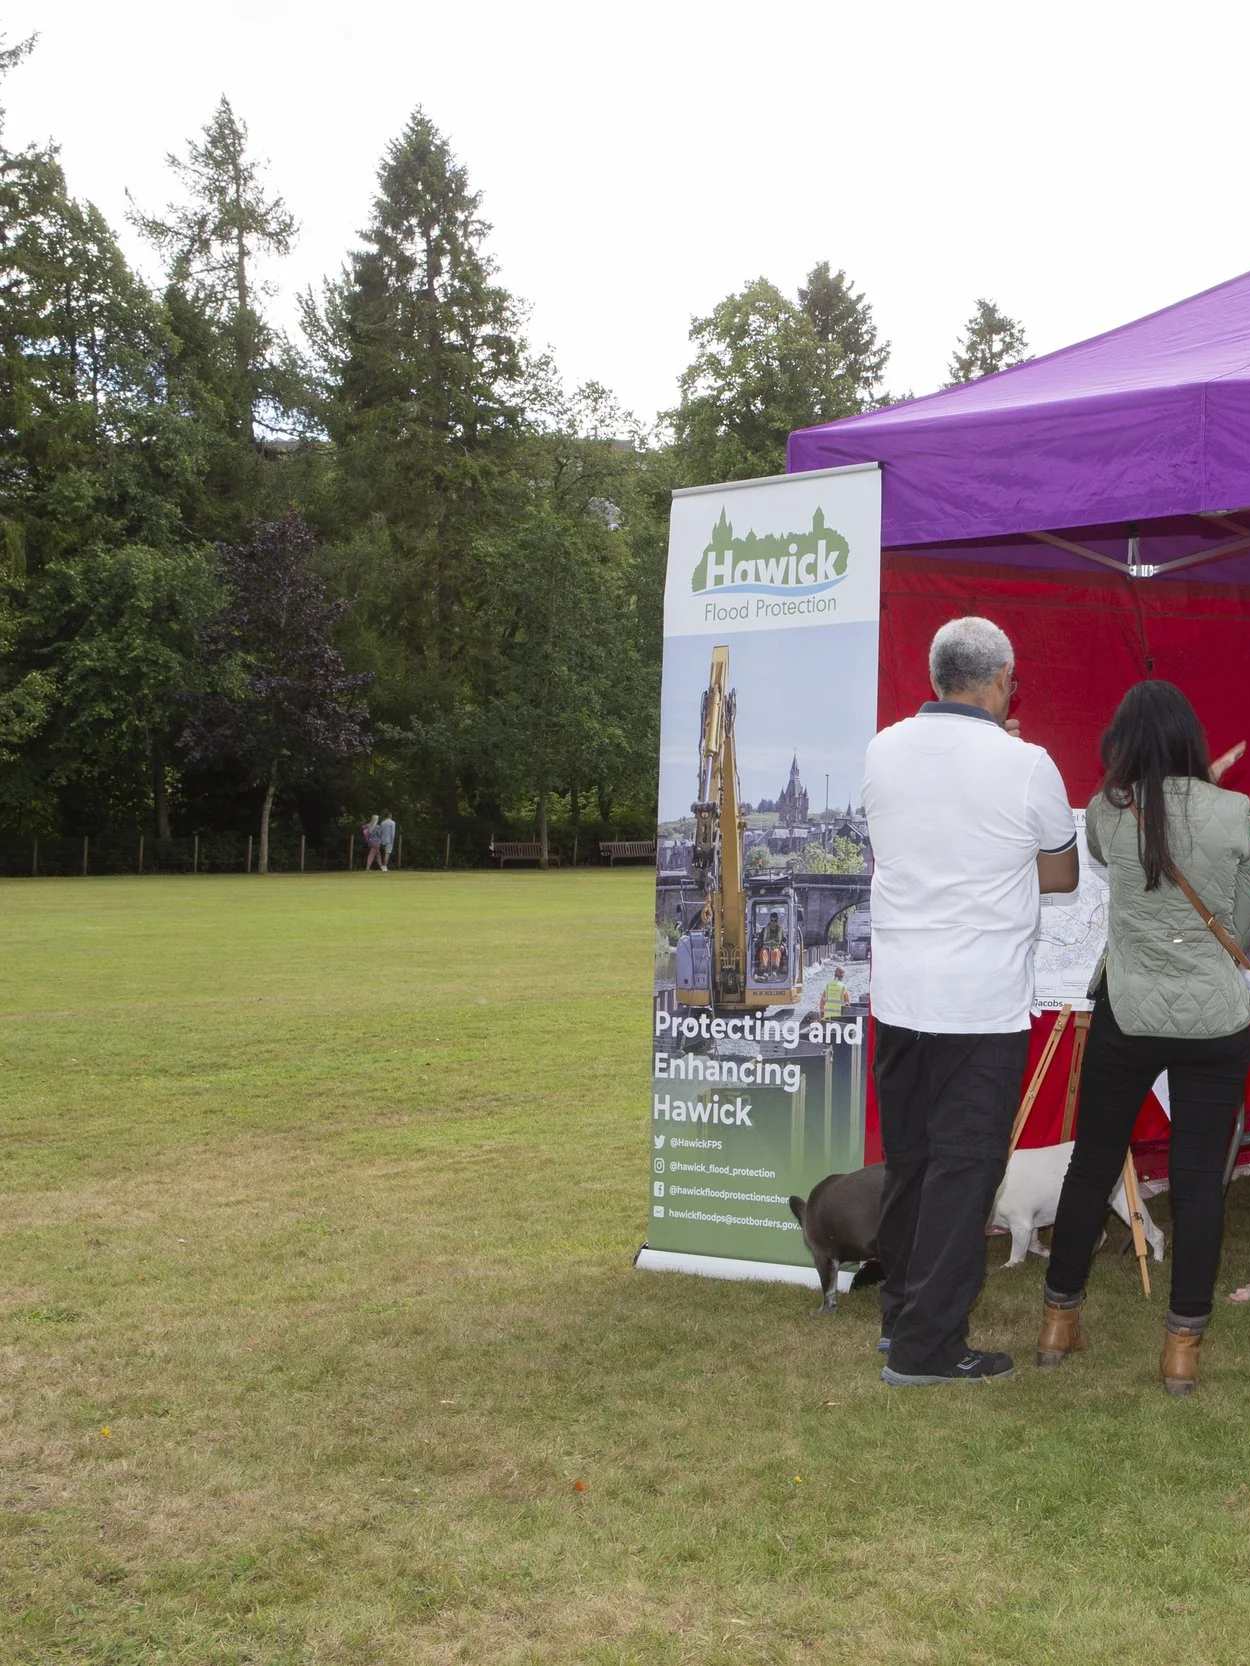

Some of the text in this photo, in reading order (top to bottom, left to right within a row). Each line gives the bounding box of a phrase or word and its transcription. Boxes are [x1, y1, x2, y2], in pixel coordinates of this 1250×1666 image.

[706, 540, 841, 590] Hawick
[704, 595, 837, 622] Flood Protection
[655, 1009, 863, 1049] Protecting and
[654, 1052, 801, 1093] Enhancing
[653, 1094, 753, 1127] Hawick
[670, 1137, 723, 1150] @HawickFPS
[669, 1160, 776, 1180] @hawick_flood_protection
